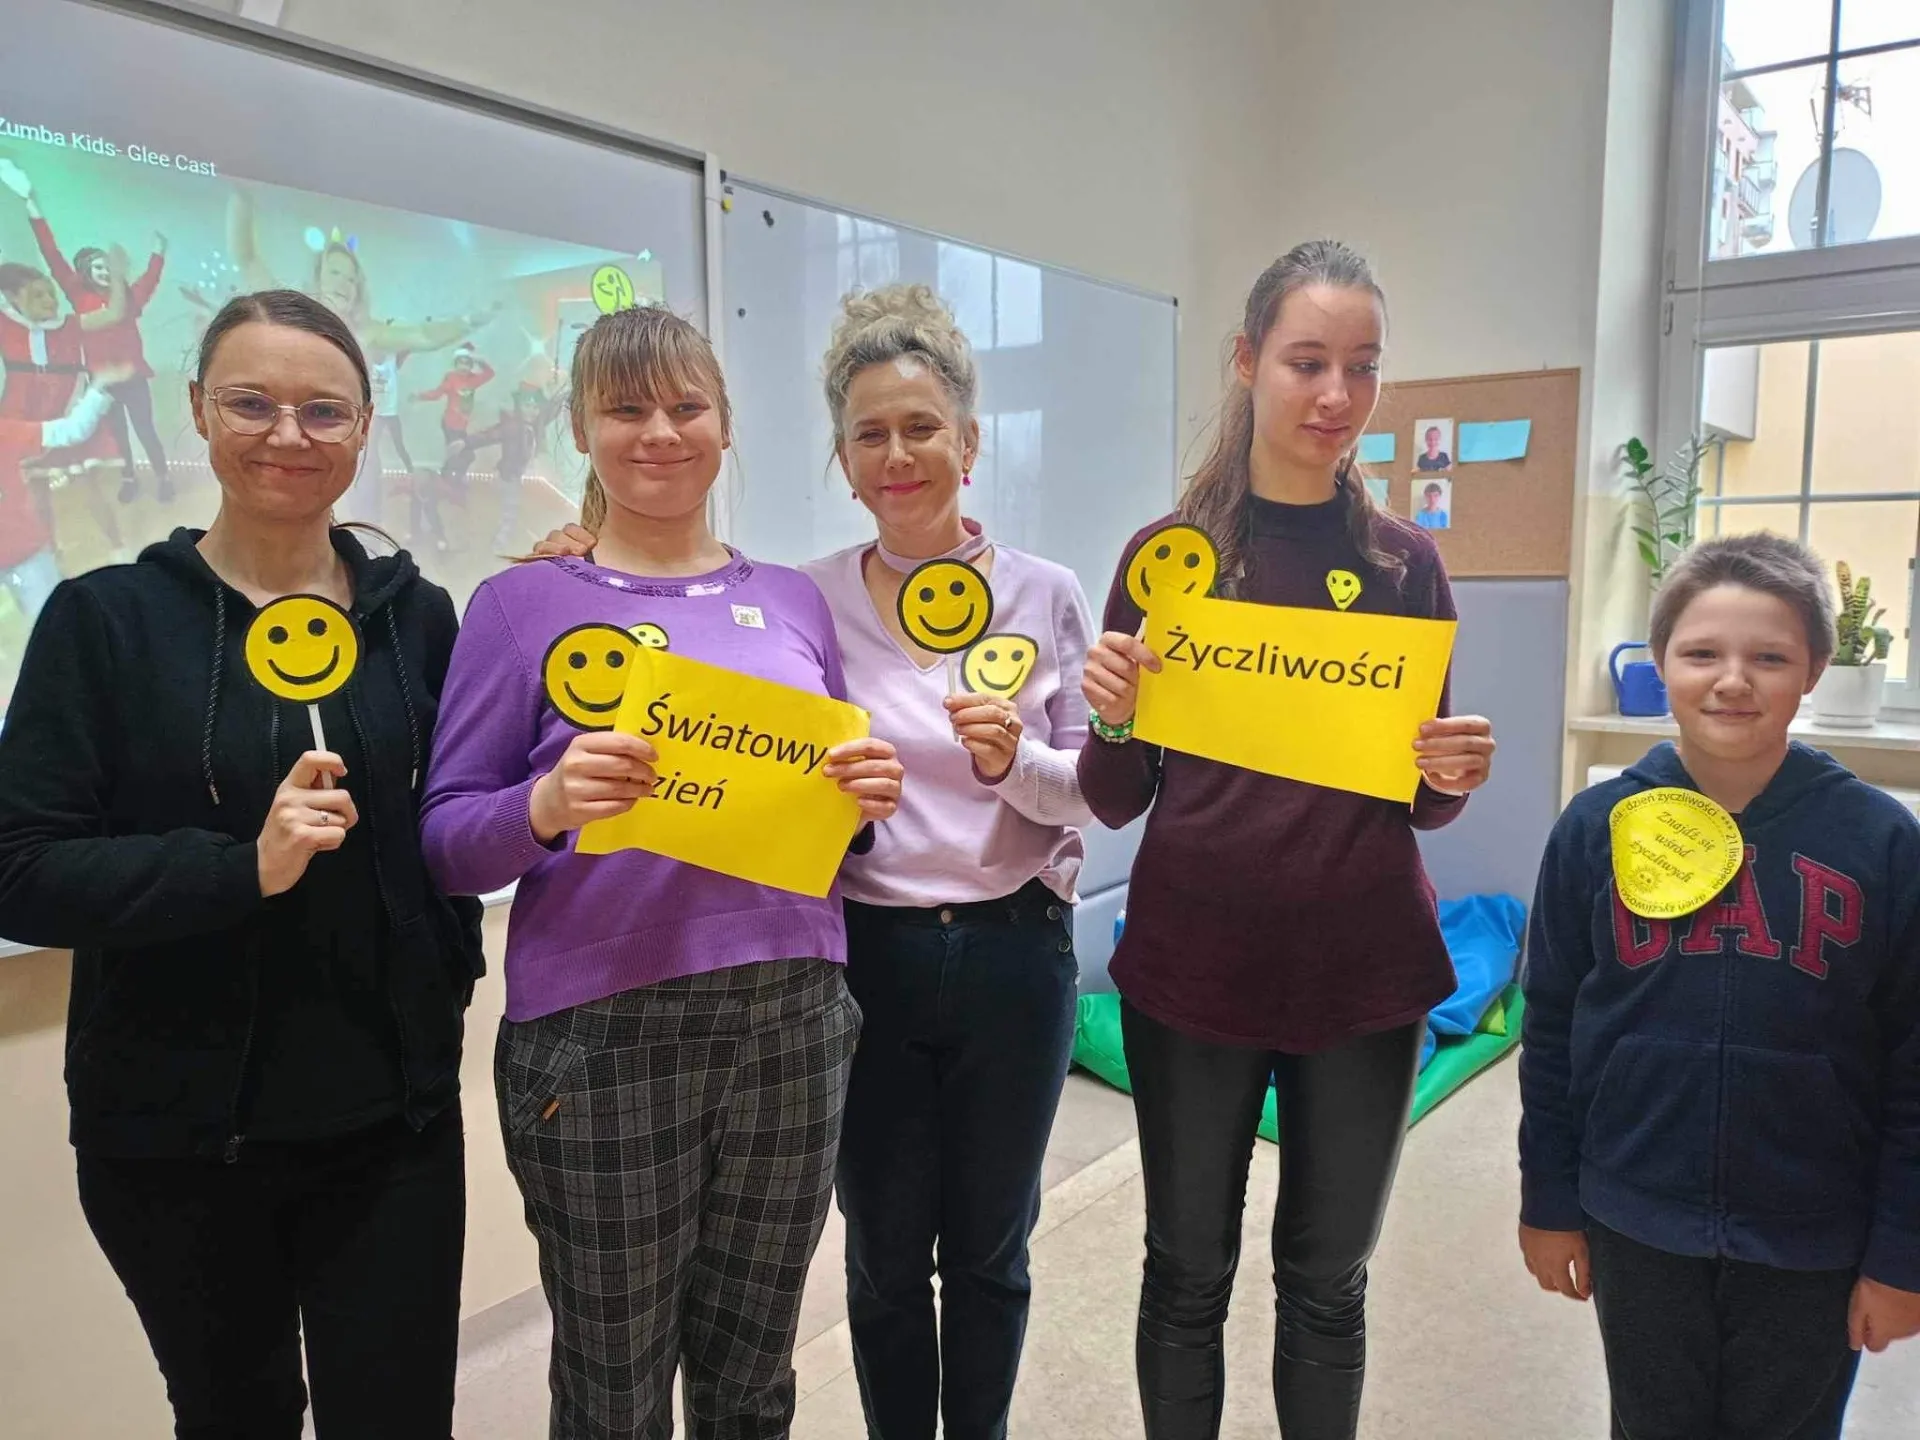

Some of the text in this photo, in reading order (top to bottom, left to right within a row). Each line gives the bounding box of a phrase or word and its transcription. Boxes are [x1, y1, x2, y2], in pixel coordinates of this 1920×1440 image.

[0, 117, 217, 177] Zumba Kids- Glee Cast
[1163, 625, 1406, 690] Życzliwości
[641, 693, 829, 775] Światowy
[649, 771, 729, 810] zień
